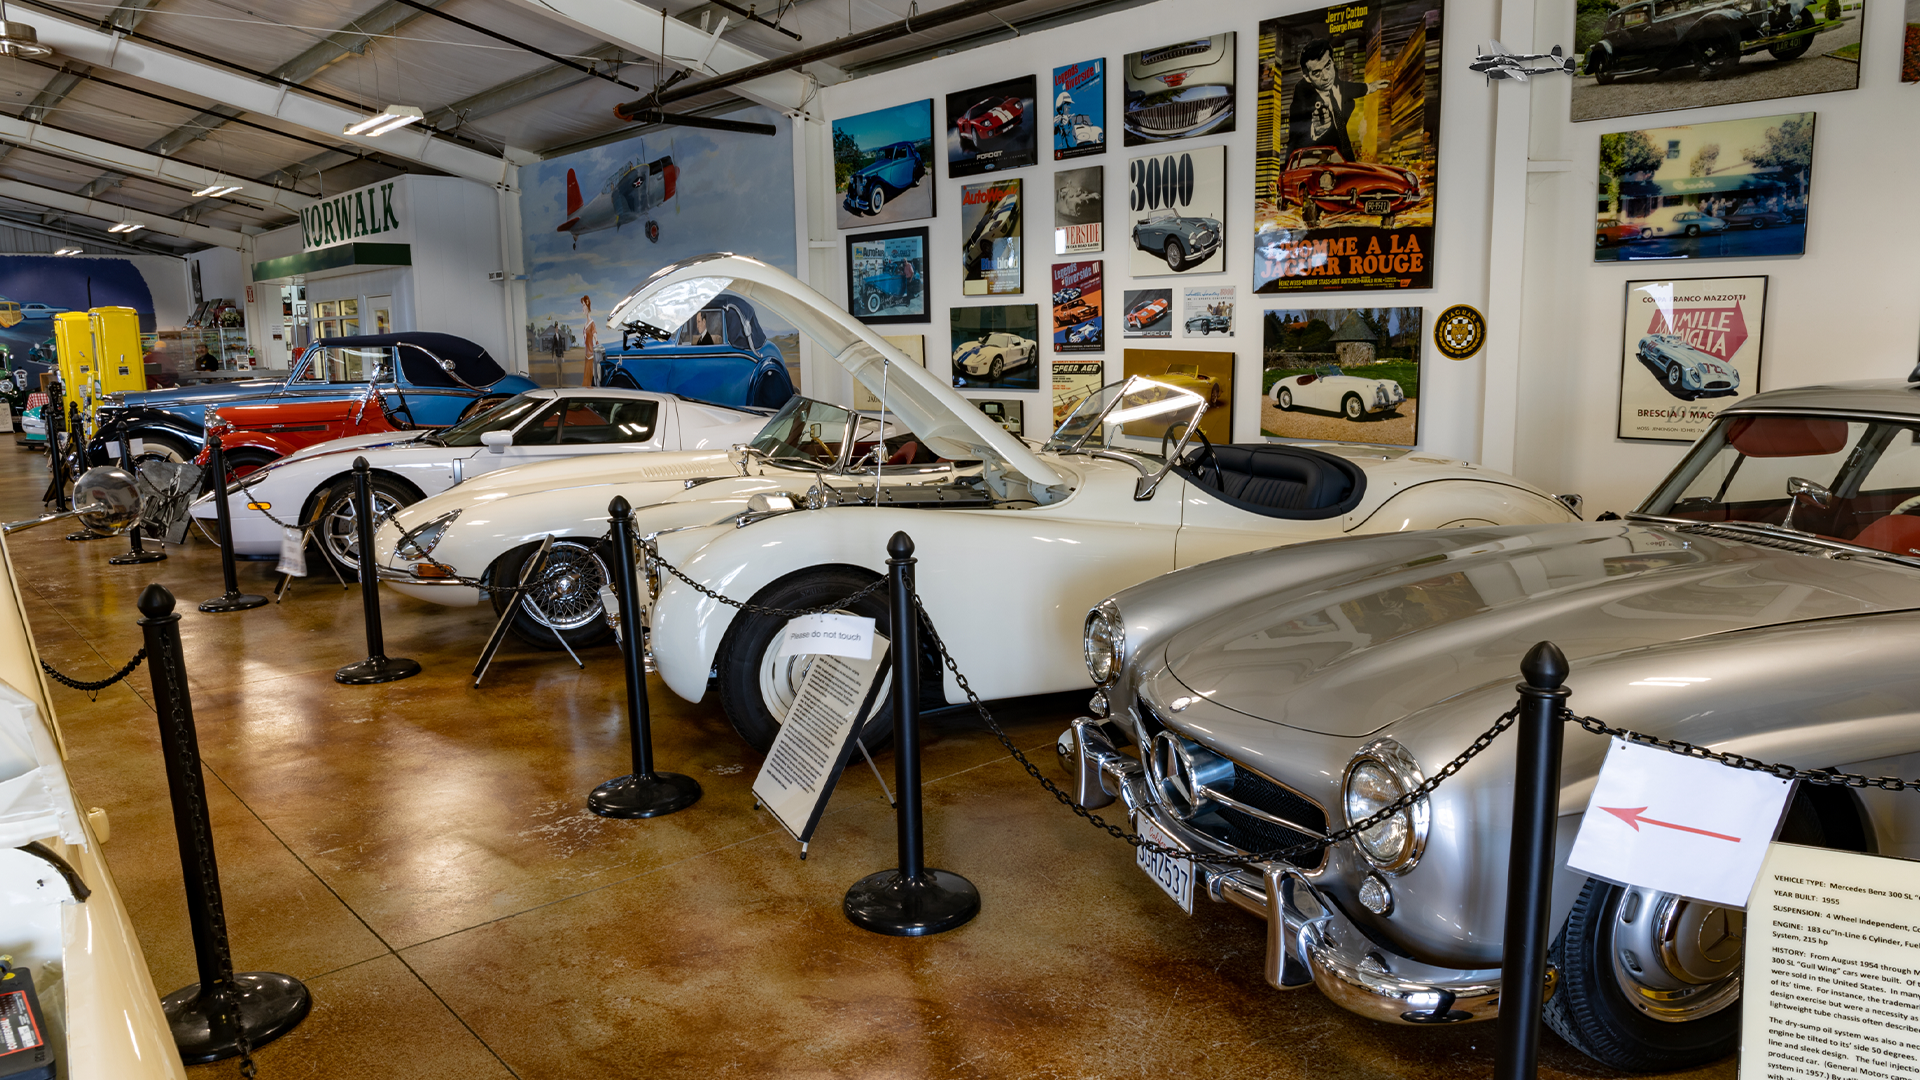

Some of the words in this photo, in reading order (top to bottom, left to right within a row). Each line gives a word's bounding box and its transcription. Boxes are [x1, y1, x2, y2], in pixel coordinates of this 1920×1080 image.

[1326, 11, 1344, 23] Jerry
[1346, 6, 1368, 19] Cotton
[1330, 23, 1347, 33] George
[1348, 19, 1363, 29] Nader
[1055, 64, 1078, 86] Legends
[1066, 66, 1094, 91] Riverside
[1130, 153, 1194, 212] 3000
[300, 182, 399, 249] NORWALK
[1056, 224, 1099, 245] VERSIDE
[1366, 236, 1382, 254] A
[1389, 234, 1421, 253] LA
[1054, 262, 1077, 280] Legends
[1065, 266, 1092, 286] Riverside
[1261, 257, 1341, 278] JAGUAR
[1349, 253, 1423, 275] ROUGE
[1446, 309, 1476, 321] JAGUAR
[1678, 311, 1734, 332] MILLE
[1673, 327, 1726, 357] MIGLIA
[1052, 365, 1078, 373] SPEED
[1638, 409, 1677, 418] BRESCIA
[1690, 411, 1715, 419] MAG
[1665, 405, 1708, 424] 1955
[839, 632, 861, 641] touch
[1774, 875, 1804, 884] VEHICLE
[1806, 879, 1826, 887] TYPE:
[1830, 883, 1866, 893] Mercedes
[1868, 888, 1886, 896] Benz
[1795, 893, 1818, 901] BUILT:
[1773, 905, 1822, 917] SUSPENSION:
[1833, 914, 1857, 923] Wheel
[1859, 918, 1910, 932] Independent,
[1773, 920, 1803, 930] ENGINE:
[1869, 935, 1902, 947] Cylinder,
[1773, 931, 1801, 941] System,
[1772, 947, 1806, 957] HISTORY:
[1810, 953, 1830, 961] From
[1831, 956, 1857, 966] August
[1880, 964, 1911, 975] through
[1833, 978, 1858, 988] United
[1860, 983, 1886, 993] States.
[1882, 975, 1901, 984] built.
[1793, 983, 1812, 991] time.
[1831, 989, 1865, 1001] instance,
[1770, 990, 1794, 1000] design
[1796, 996, 1826, 1005] exercise
[1829, 1000, 1842, 1008] but
[1872, 1009, 1908, 1020] necessity
[1770, 1001, 1812, 1014] lightweight
[1814, 1009, 1831, 1017] tube
[1834, 1012, 1860, 1022] chassis
[1862, 1018, 1883, 1026] often
[1769, 1016, 1783, 1024] The
[1785, 1020, 1821, 1032] dry-sump
[1834, 1030, 1861, 1039] system
[1769, 1029, 1794, 1038] engine
[1808, 1035, 1828, 1044] tilted
[1854, 1044, 1869, 1052] side
[1883, 1050, 1917, 1061] degrees.
[1769, 1038, 1782, 1047] line
[1800, 1045, 1820, 1054] sleek
[1822, 1049, 1848, 1059] design.
[1856, 1055, 1870, 1064] The
[1872, 1058, 1887, 1067] fuel
[1768, 1051, 1804, 1062] produced
[1824, 1061, 1857, 1073] (General
[1860, 1068, 1888, 1079] Motors
[1768, 1063, 1794, 1072] system
[1806, 1069, 1829, 1079] 1957.)
